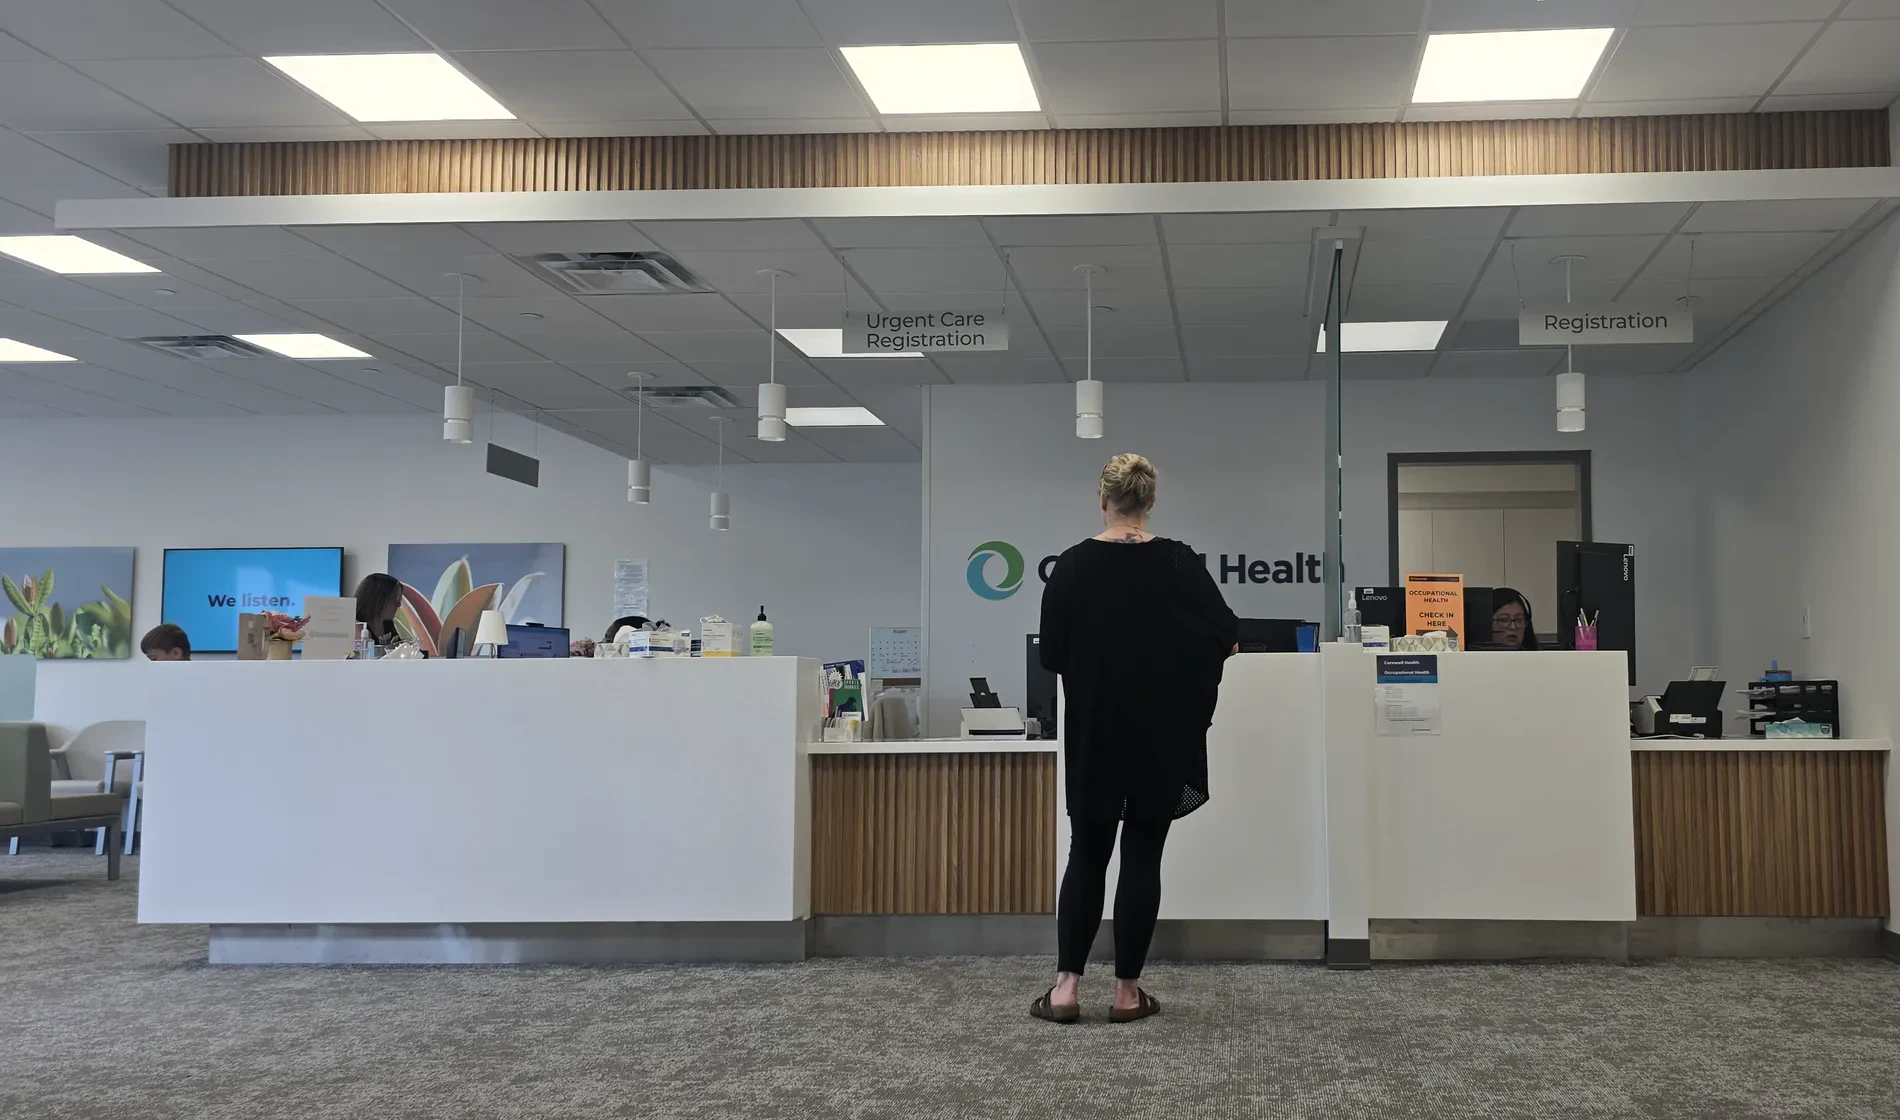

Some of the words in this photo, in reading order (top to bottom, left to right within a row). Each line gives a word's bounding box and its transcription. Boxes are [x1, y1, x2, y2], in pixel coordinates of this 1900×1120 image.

[867, 312, 935, 332] Urgent
[940, 311, 985, 327] Care
[1544, 312, 1668, 333] Registration
[867, 330, 985, 351] Registration
[207, 594, 237, 607] We
[241, 592, 296, 607] listen.
